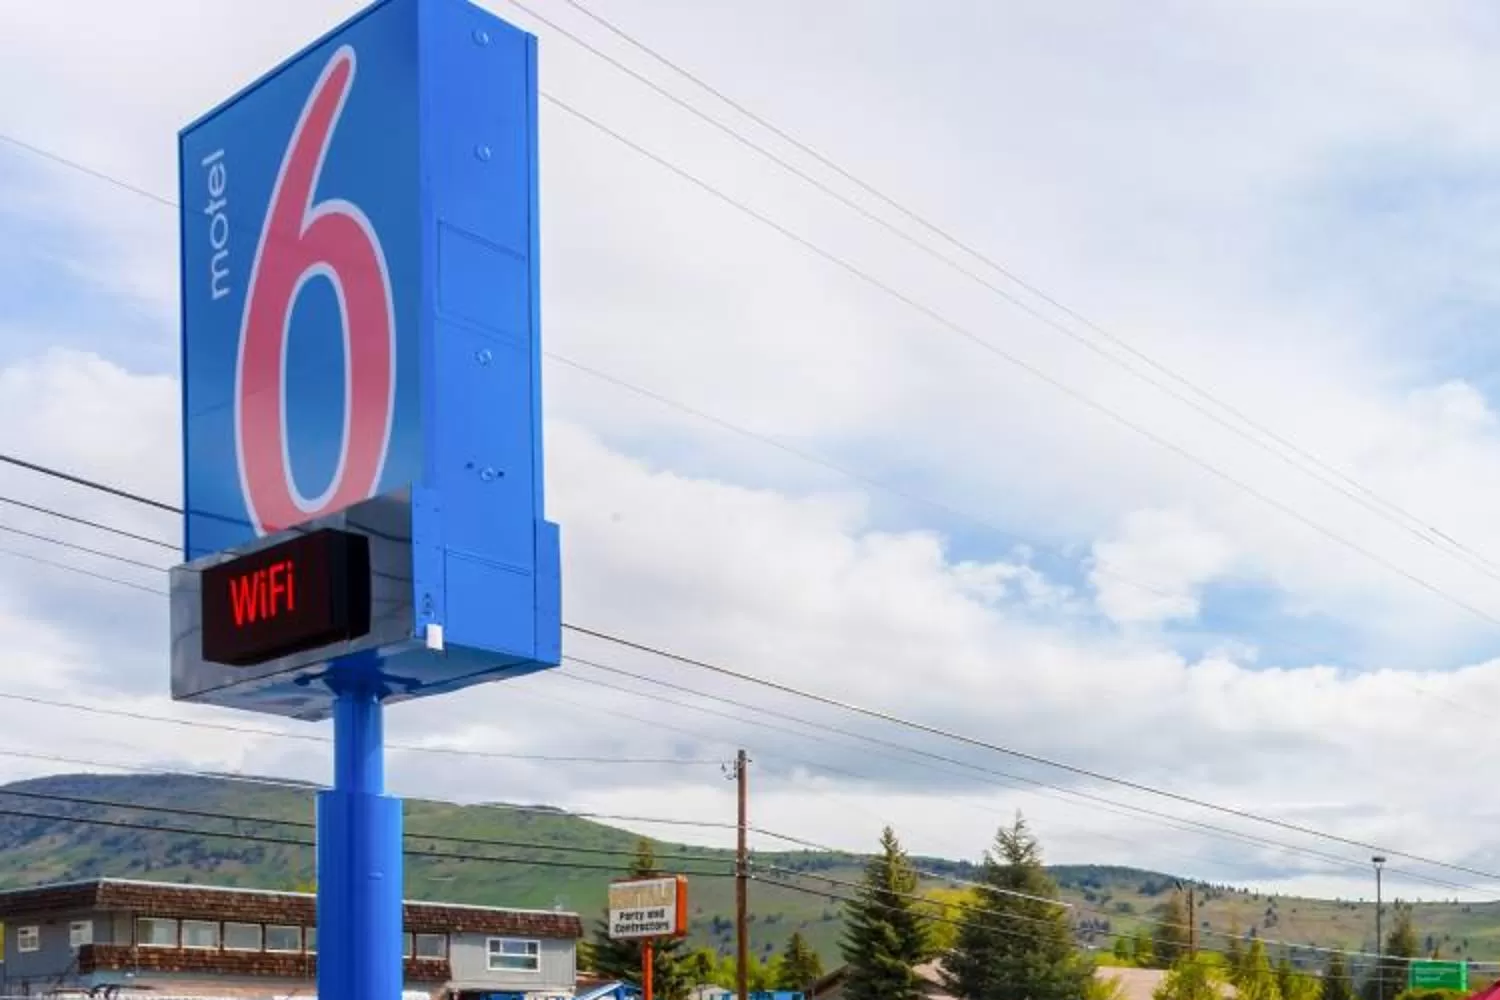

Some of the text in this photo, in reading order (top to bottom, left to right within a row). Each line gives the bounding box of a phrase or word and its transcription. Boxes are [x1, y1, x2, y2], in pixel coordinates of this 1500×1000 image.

[201, 149, 230, 299] motel
[234, 45, 396, 537] 6
[229, 560, 294, 625] WiFi
